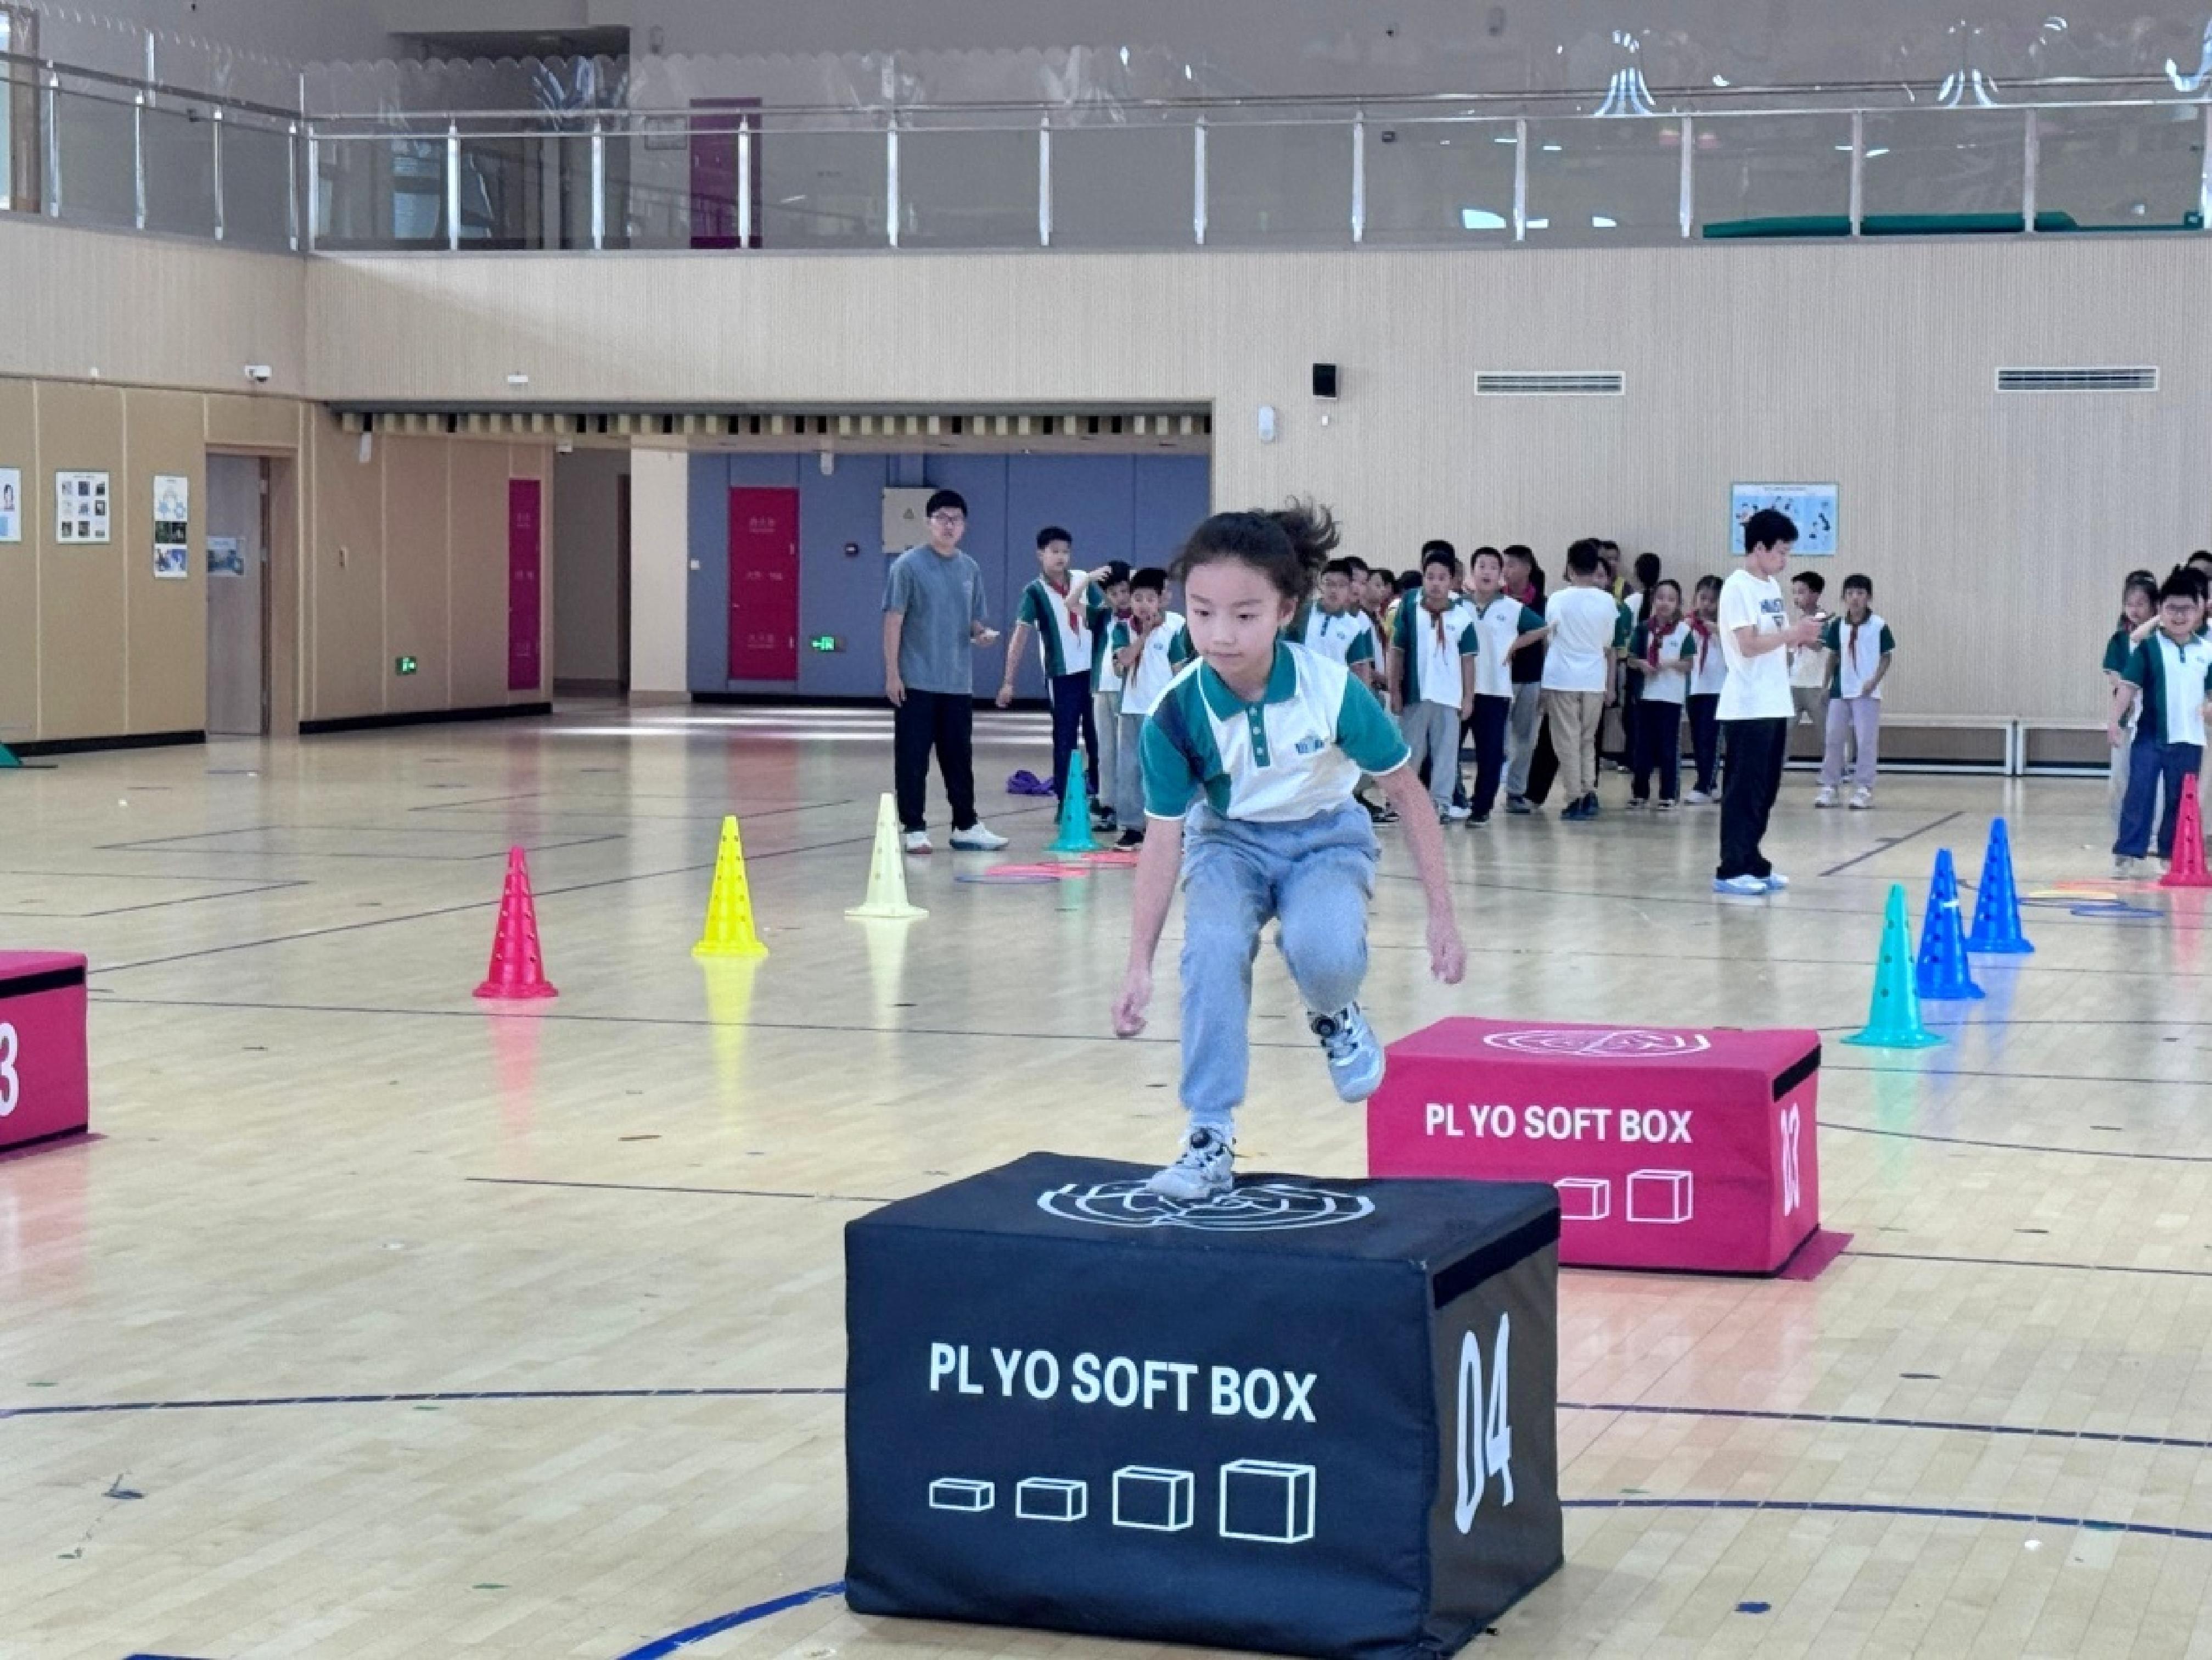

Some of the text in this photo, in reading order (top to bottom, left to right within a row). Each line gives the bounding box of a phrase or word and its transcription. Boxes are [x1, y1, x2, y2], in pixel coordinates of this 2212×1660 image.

[1524, 1104, 1612, 1140] SOFT
[1619, 1109, 1693, 1143] BOX
[1070, 1351, 1198, 1412] SOFT
[1211, 1365, 1318, 1423] BOX
[1455, 1311, 1514, 1534] 04
